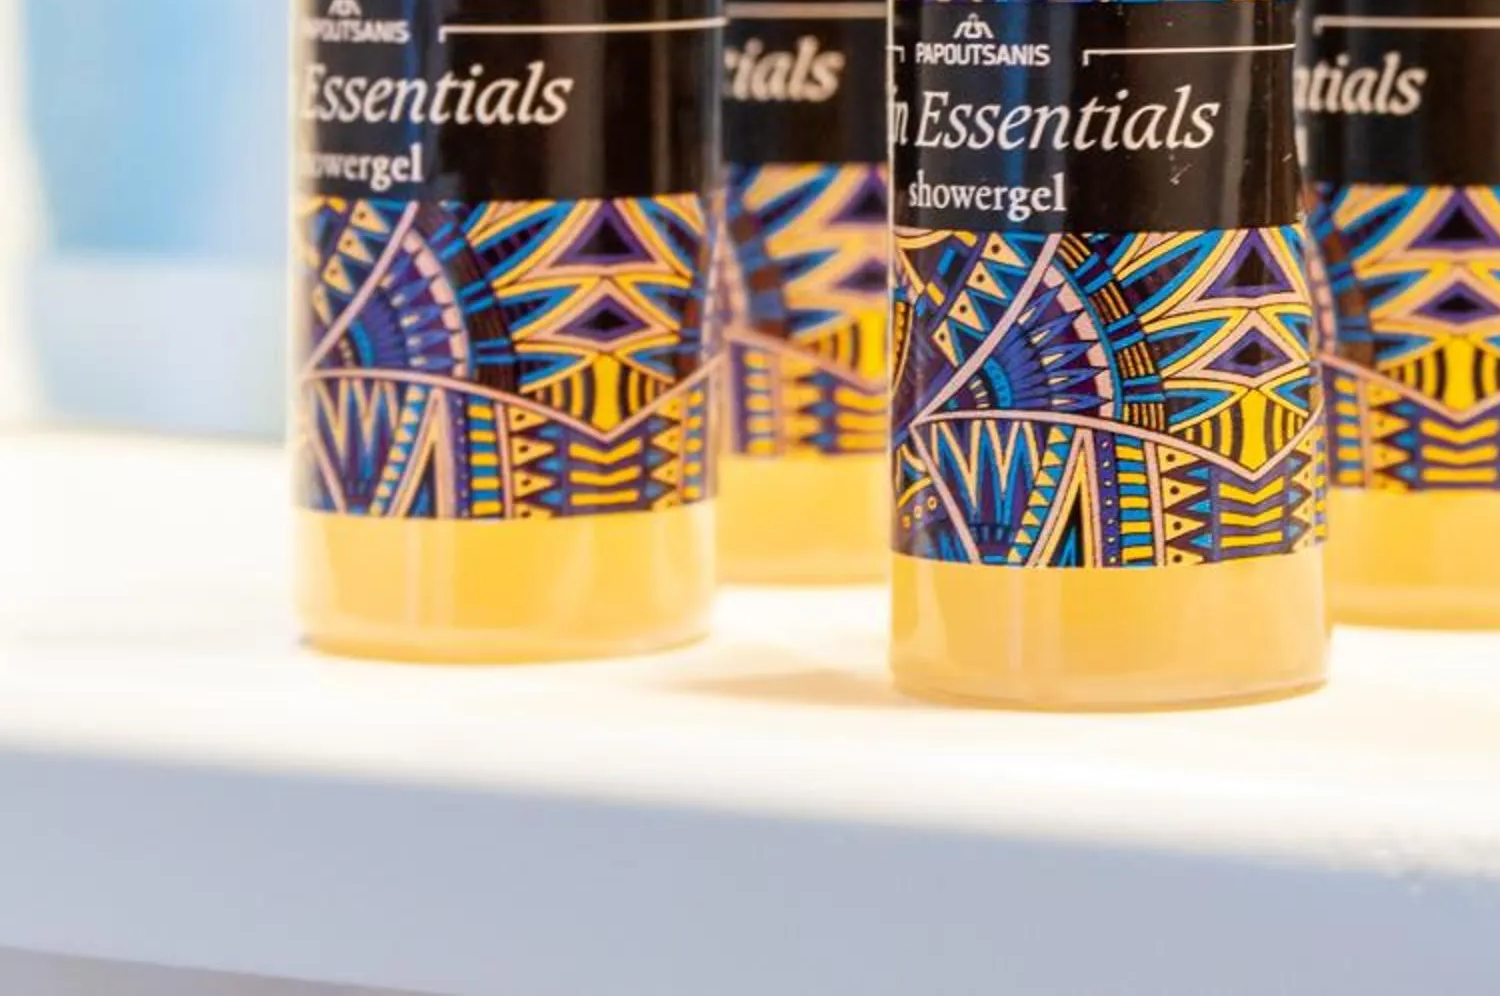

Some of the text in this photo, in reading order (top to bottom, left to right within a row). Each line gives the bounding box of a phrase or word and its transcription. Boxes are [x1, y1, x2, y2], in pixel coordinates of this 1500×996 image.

[914, 42, 1051, 67] PAPOUTSANIS
[301, 60, 574, 125] Essentials
[914, 83, 1221, 151] Essentials
[908, 168, 1068, 223] showergel
